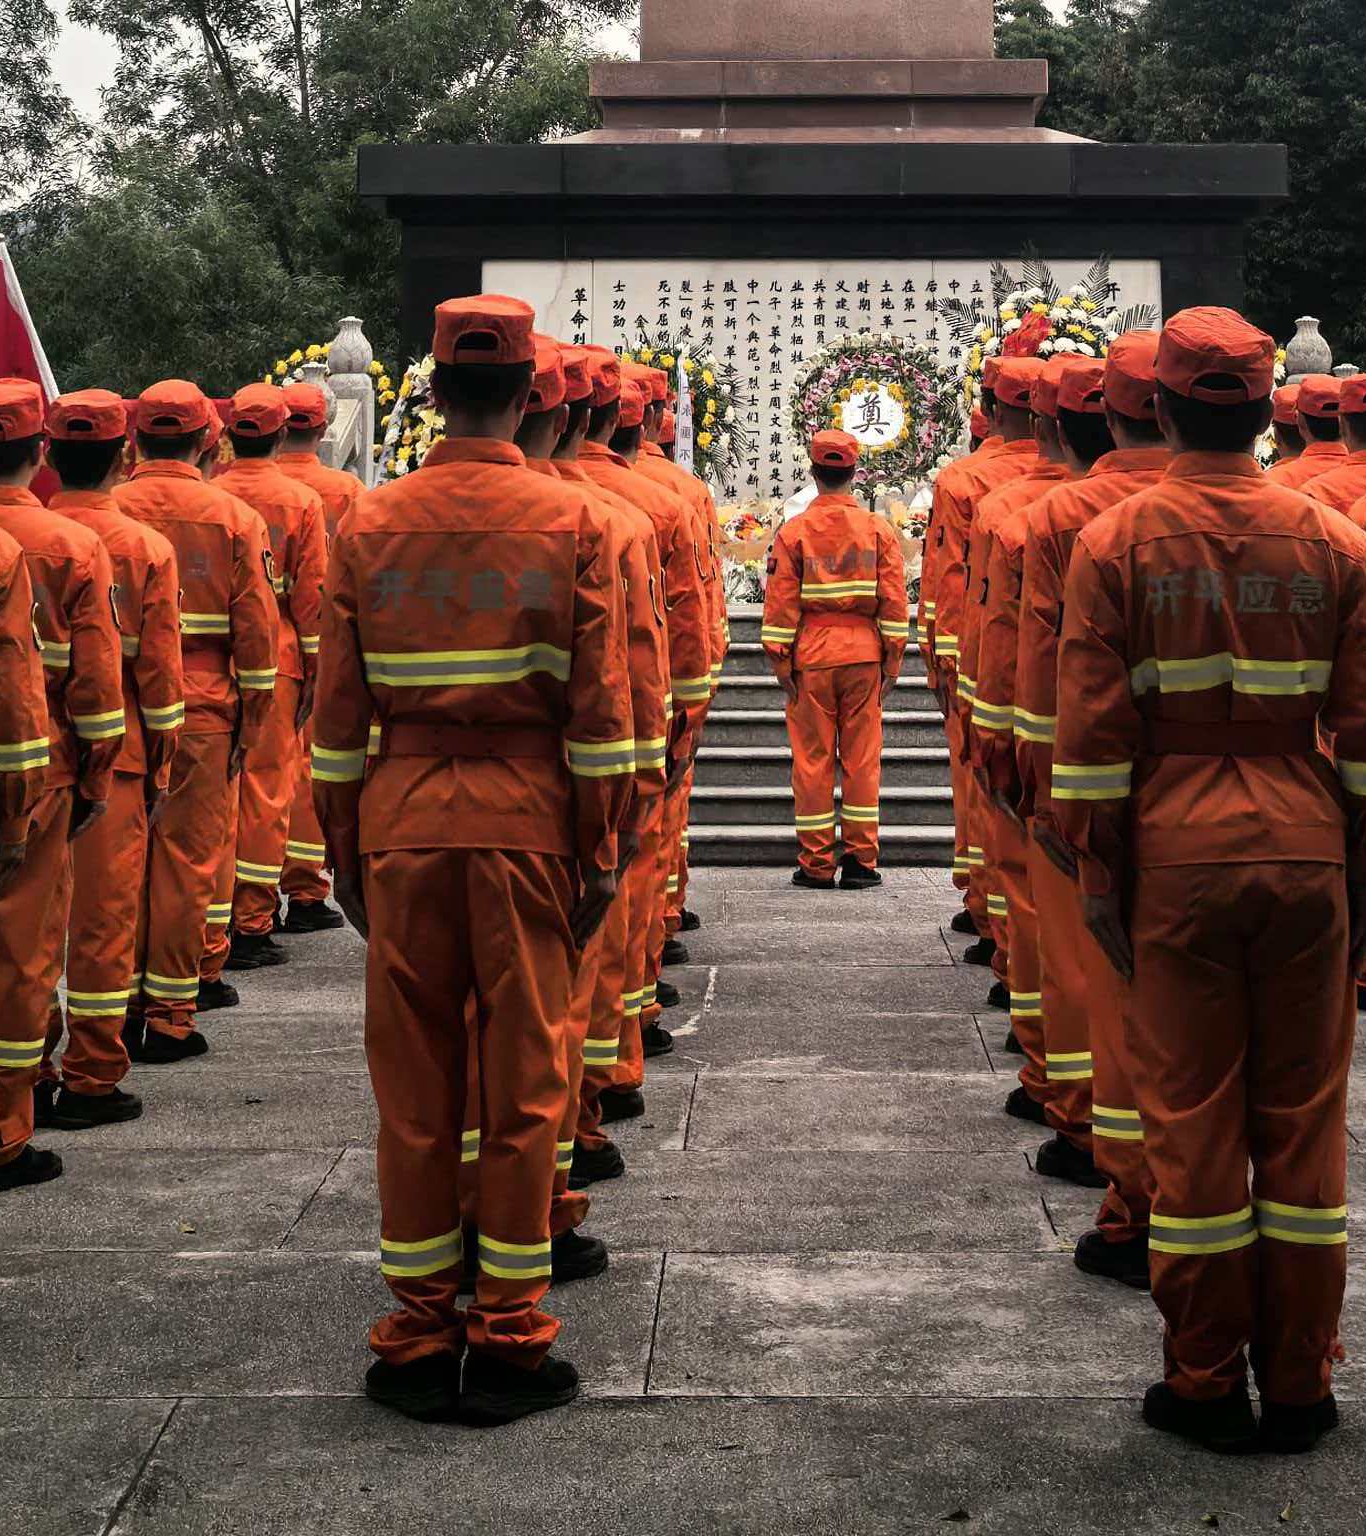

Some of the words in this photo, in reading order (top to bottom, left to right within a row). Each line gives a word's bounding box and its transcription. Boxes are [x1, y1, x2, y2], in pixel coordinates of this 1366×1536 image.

[812, 279, 827, 345] 共青团员
[835, 279, 851, 329] 义建设
[880, 279, 895, 328] 土地革
[901, 279, 917, 343] 在第一
[851, 394, 891, 436] 奠
[1145, 570, 1325, 615] 开平应急
